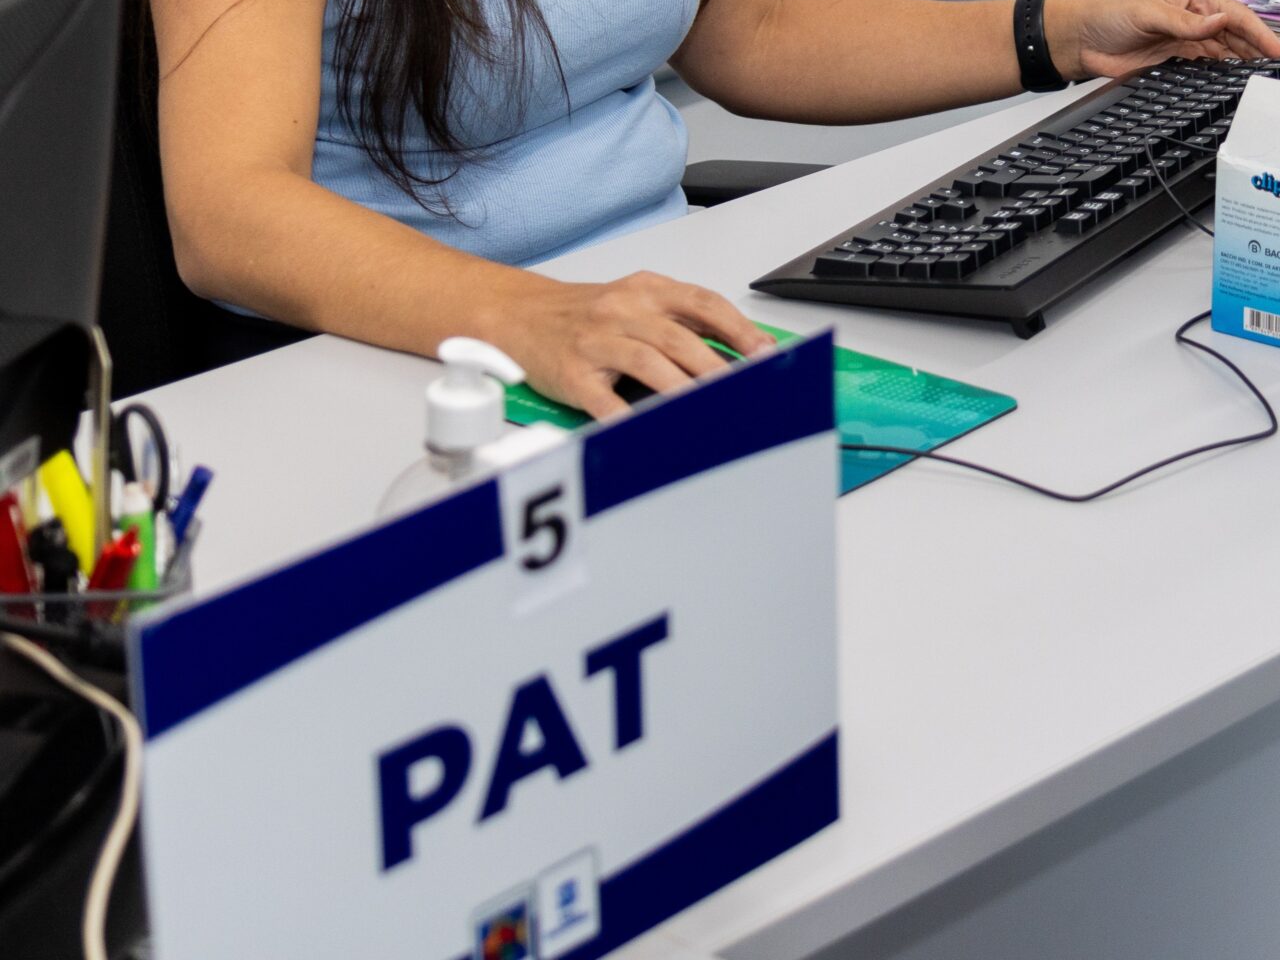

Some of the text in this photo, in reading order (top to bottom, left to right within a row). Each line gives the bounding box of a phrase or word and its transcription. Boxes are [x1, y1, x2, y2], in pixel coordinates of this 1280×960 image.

[1220, 251, 1237, 260] BACCHI
[518, 483, 568, 572] 5
[375, 610, 671, 872] PAT
